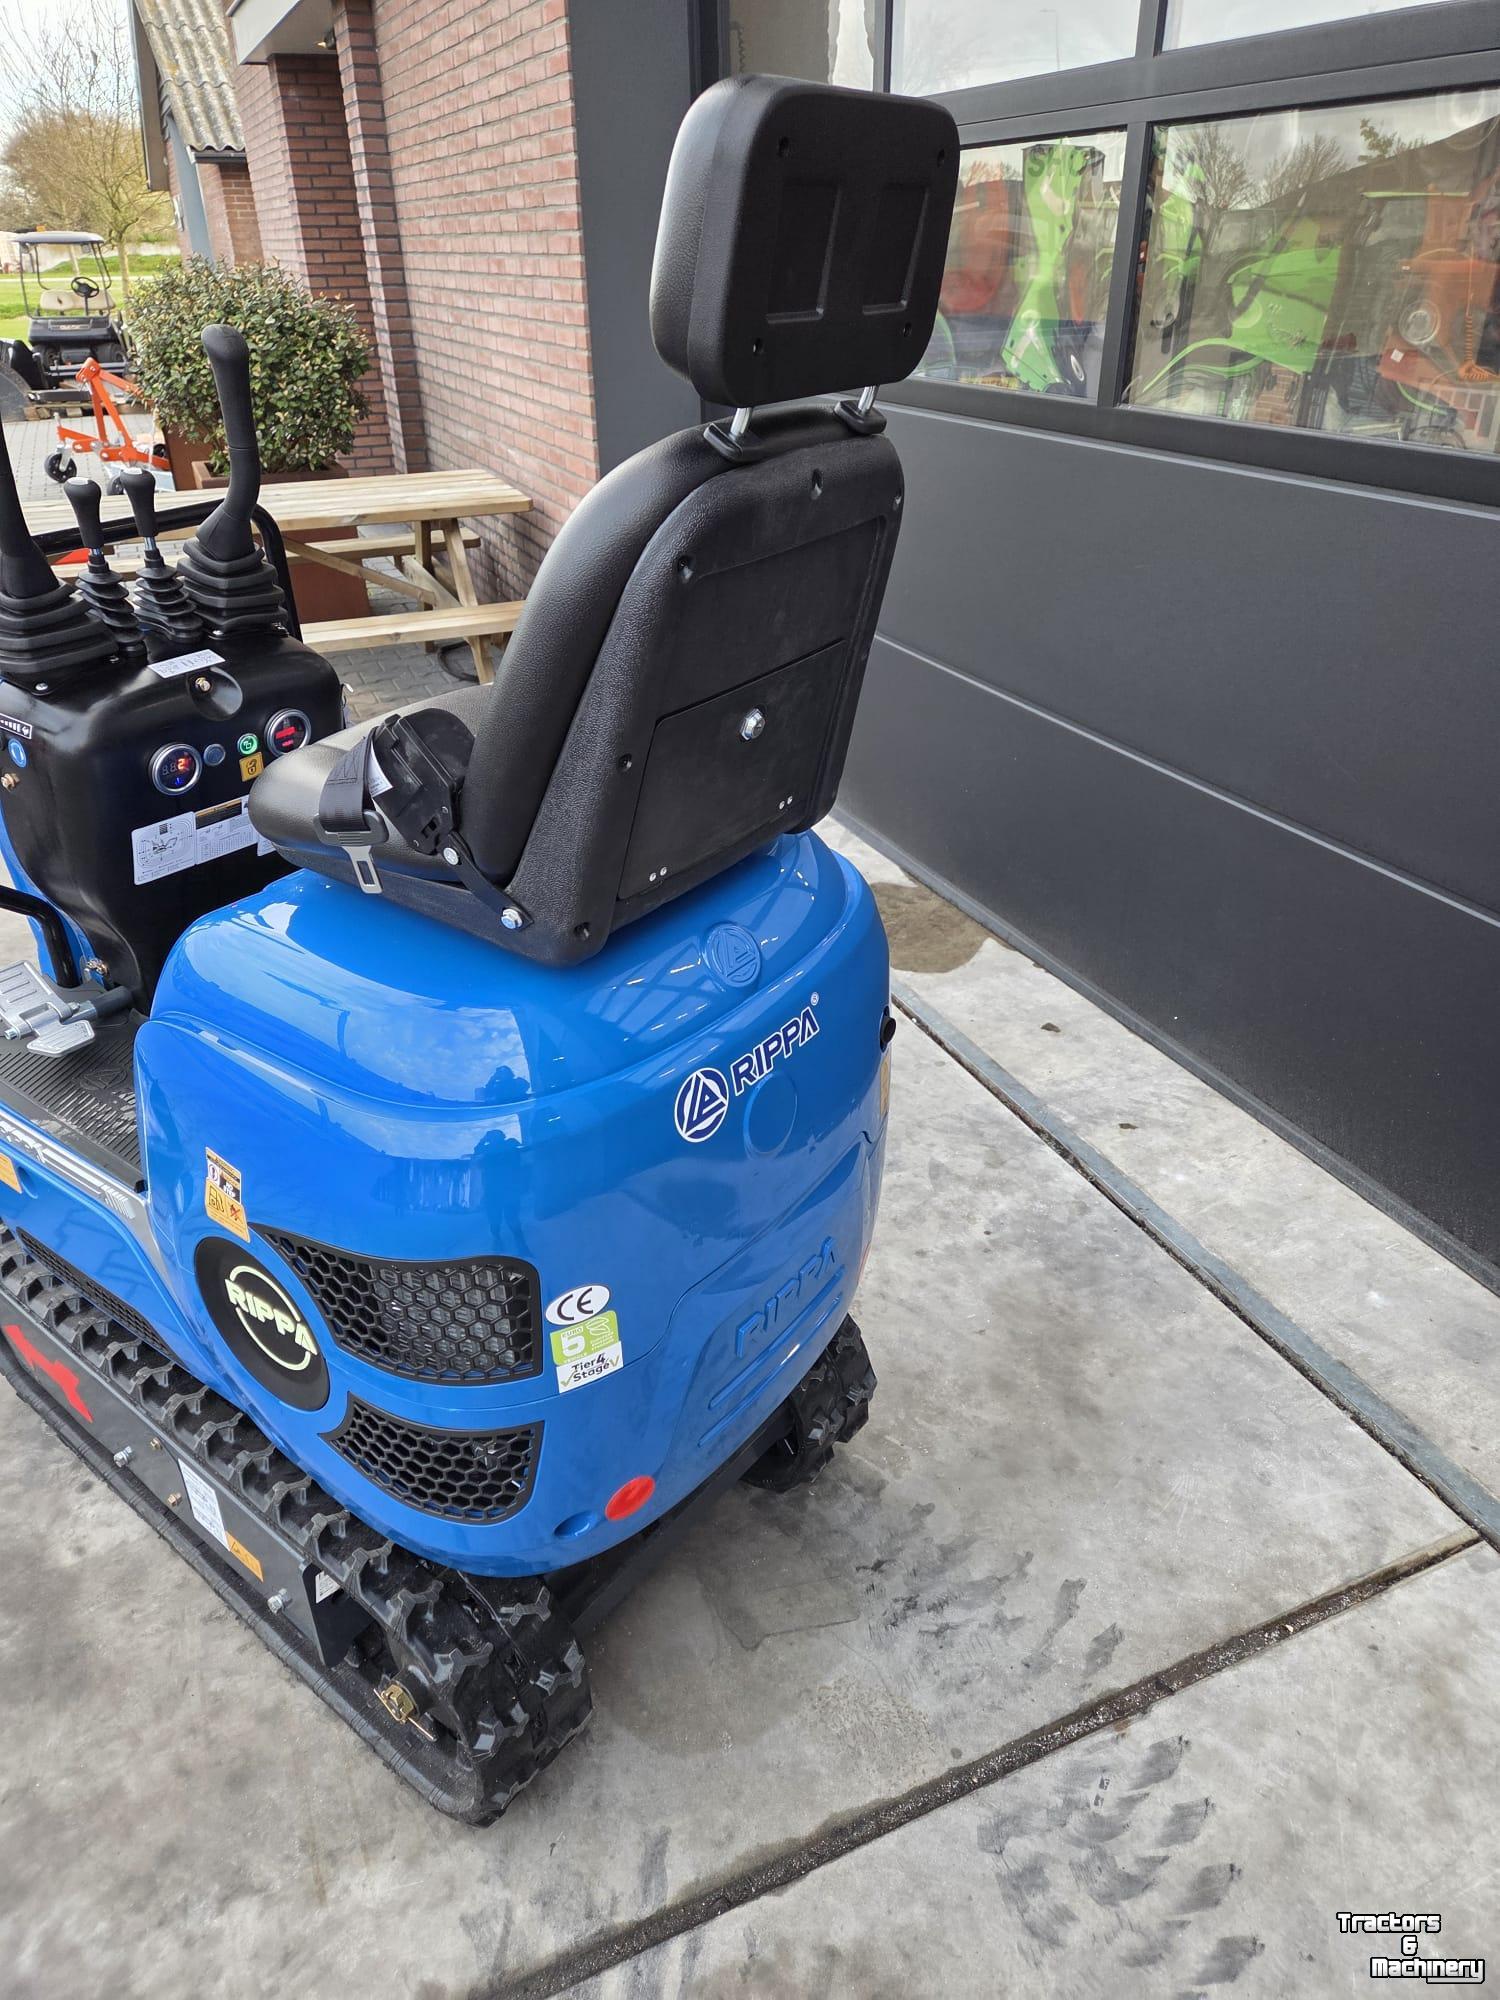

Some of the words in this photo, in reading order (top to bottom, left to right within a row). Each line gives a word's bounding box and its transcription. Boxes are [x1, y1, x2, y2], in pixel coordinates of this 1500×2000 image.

[730, 1006, 820, 1096] RIPPA
[224, 1278, 318, 1356] RIPPA
[556, 1287, 594, 1321] CE
